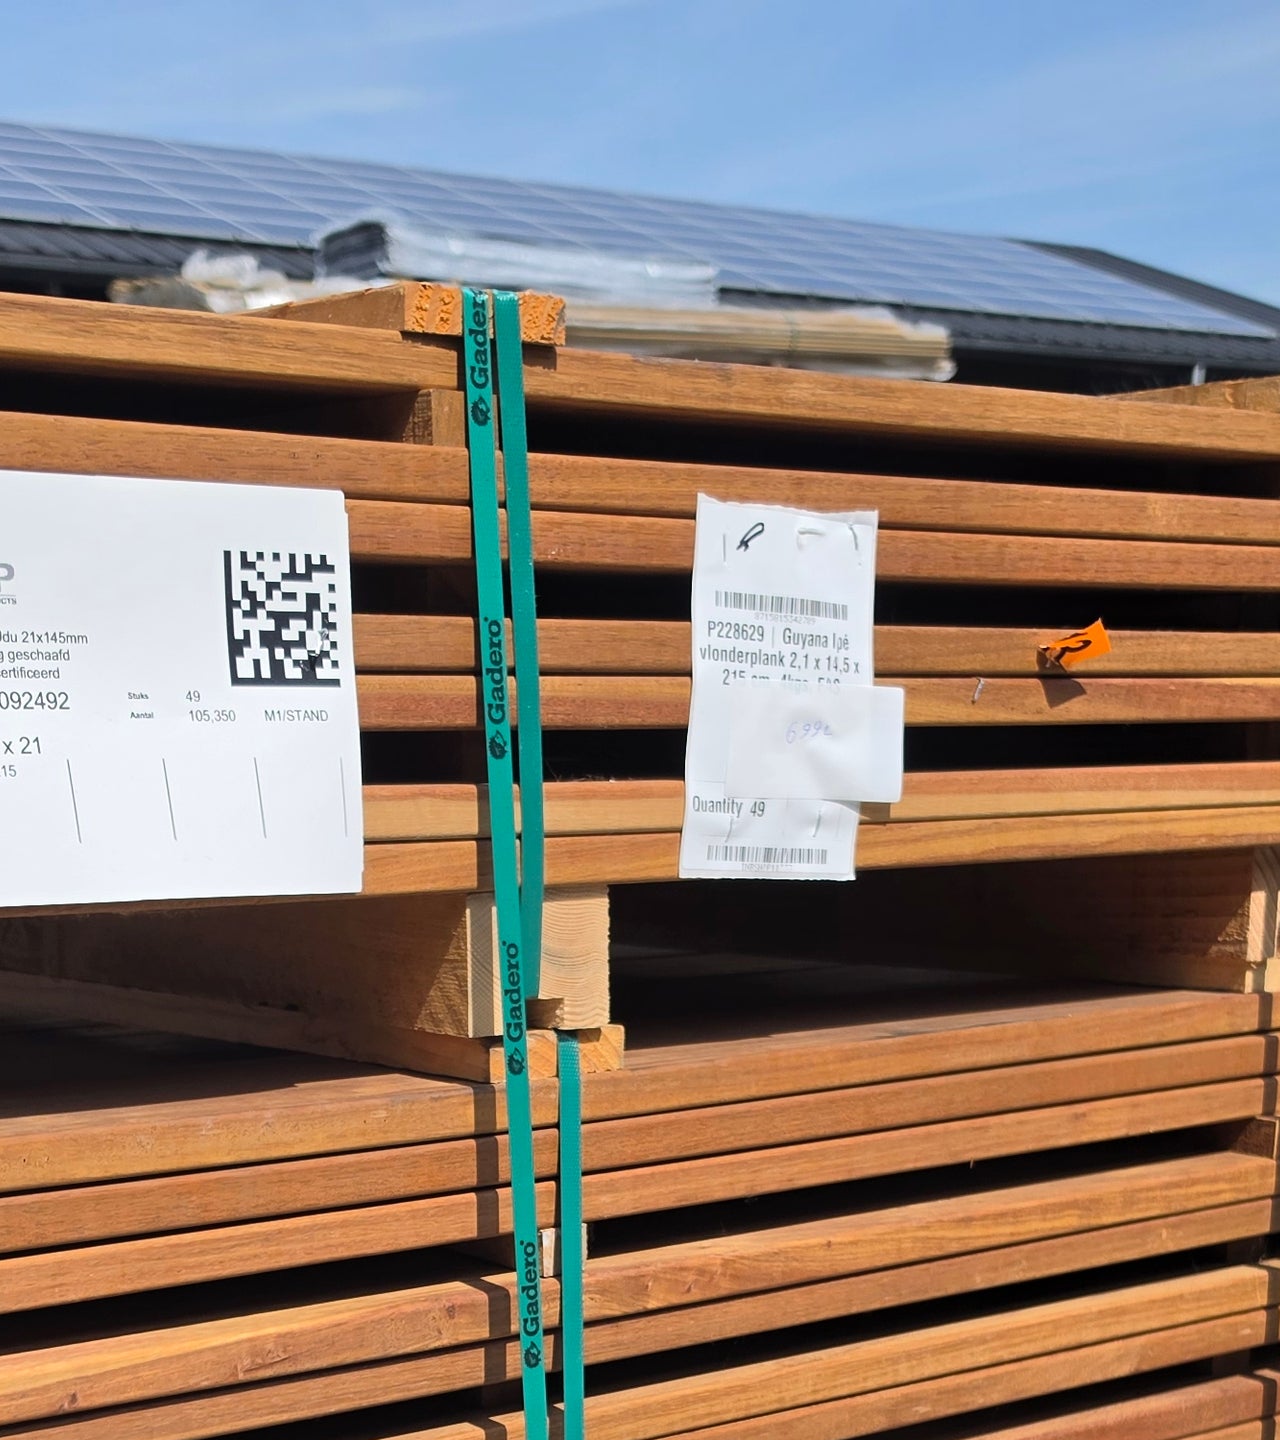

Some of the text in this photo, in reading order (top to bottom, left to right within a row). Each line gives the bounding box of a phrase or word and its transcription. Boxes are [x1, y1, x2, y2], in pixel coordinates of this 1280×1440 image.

[21, 631, 88, 644] 21x145mm
[707, 620, 765, 642] P228629
[782, 627, 828, 650] Guyana
[7, 649, 71, 663] geschaafd
[699, 644, 785, 668] vlonderplank
[814, 657, 820, 670] x
[853, 661, 860, 674] x
[487, 619, 506, 726] Gadero
[127, 690, 201, 703] Stuks 49
[130, 709, 329, 723] Aantal 105,350 M1/STAND
[2, 740, 15, 755] x
[19, 736, 42, 755] 21
[692, 795, 766, 818] Quantity 49
[504, 942, 524, 1043] Gadero
[522, 1241, 541, 1338] Gadero
